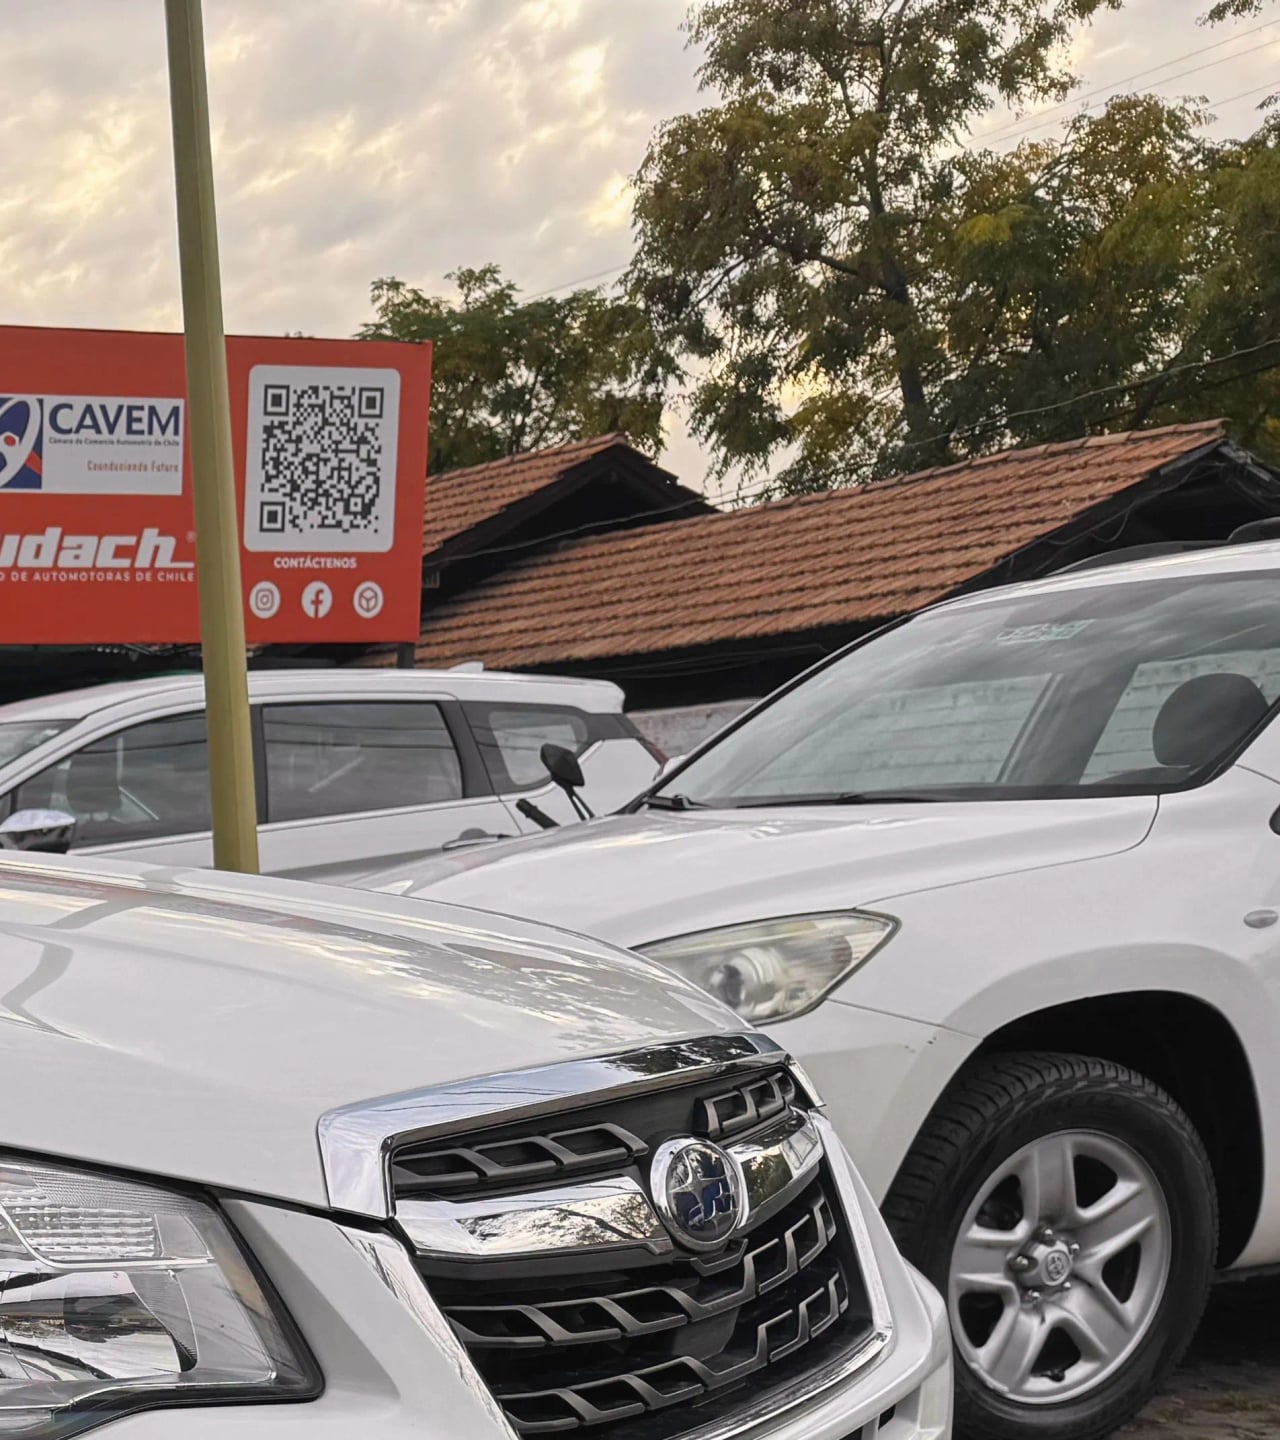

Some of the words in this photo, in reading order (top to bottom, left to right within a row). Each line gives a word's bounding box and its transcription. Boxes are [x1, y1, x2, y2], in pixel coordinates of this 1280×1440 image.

[48, 403, 180, 436] CAVEM
[273, 554, 358, 569] CONTÁCTENOS
[11, 571, 28, 582] DE
[33, 571, 130, 582] AUTOMOTORAS
[135, 572, 152, 582] DE
[157, 572, 195, 582] CHILE
